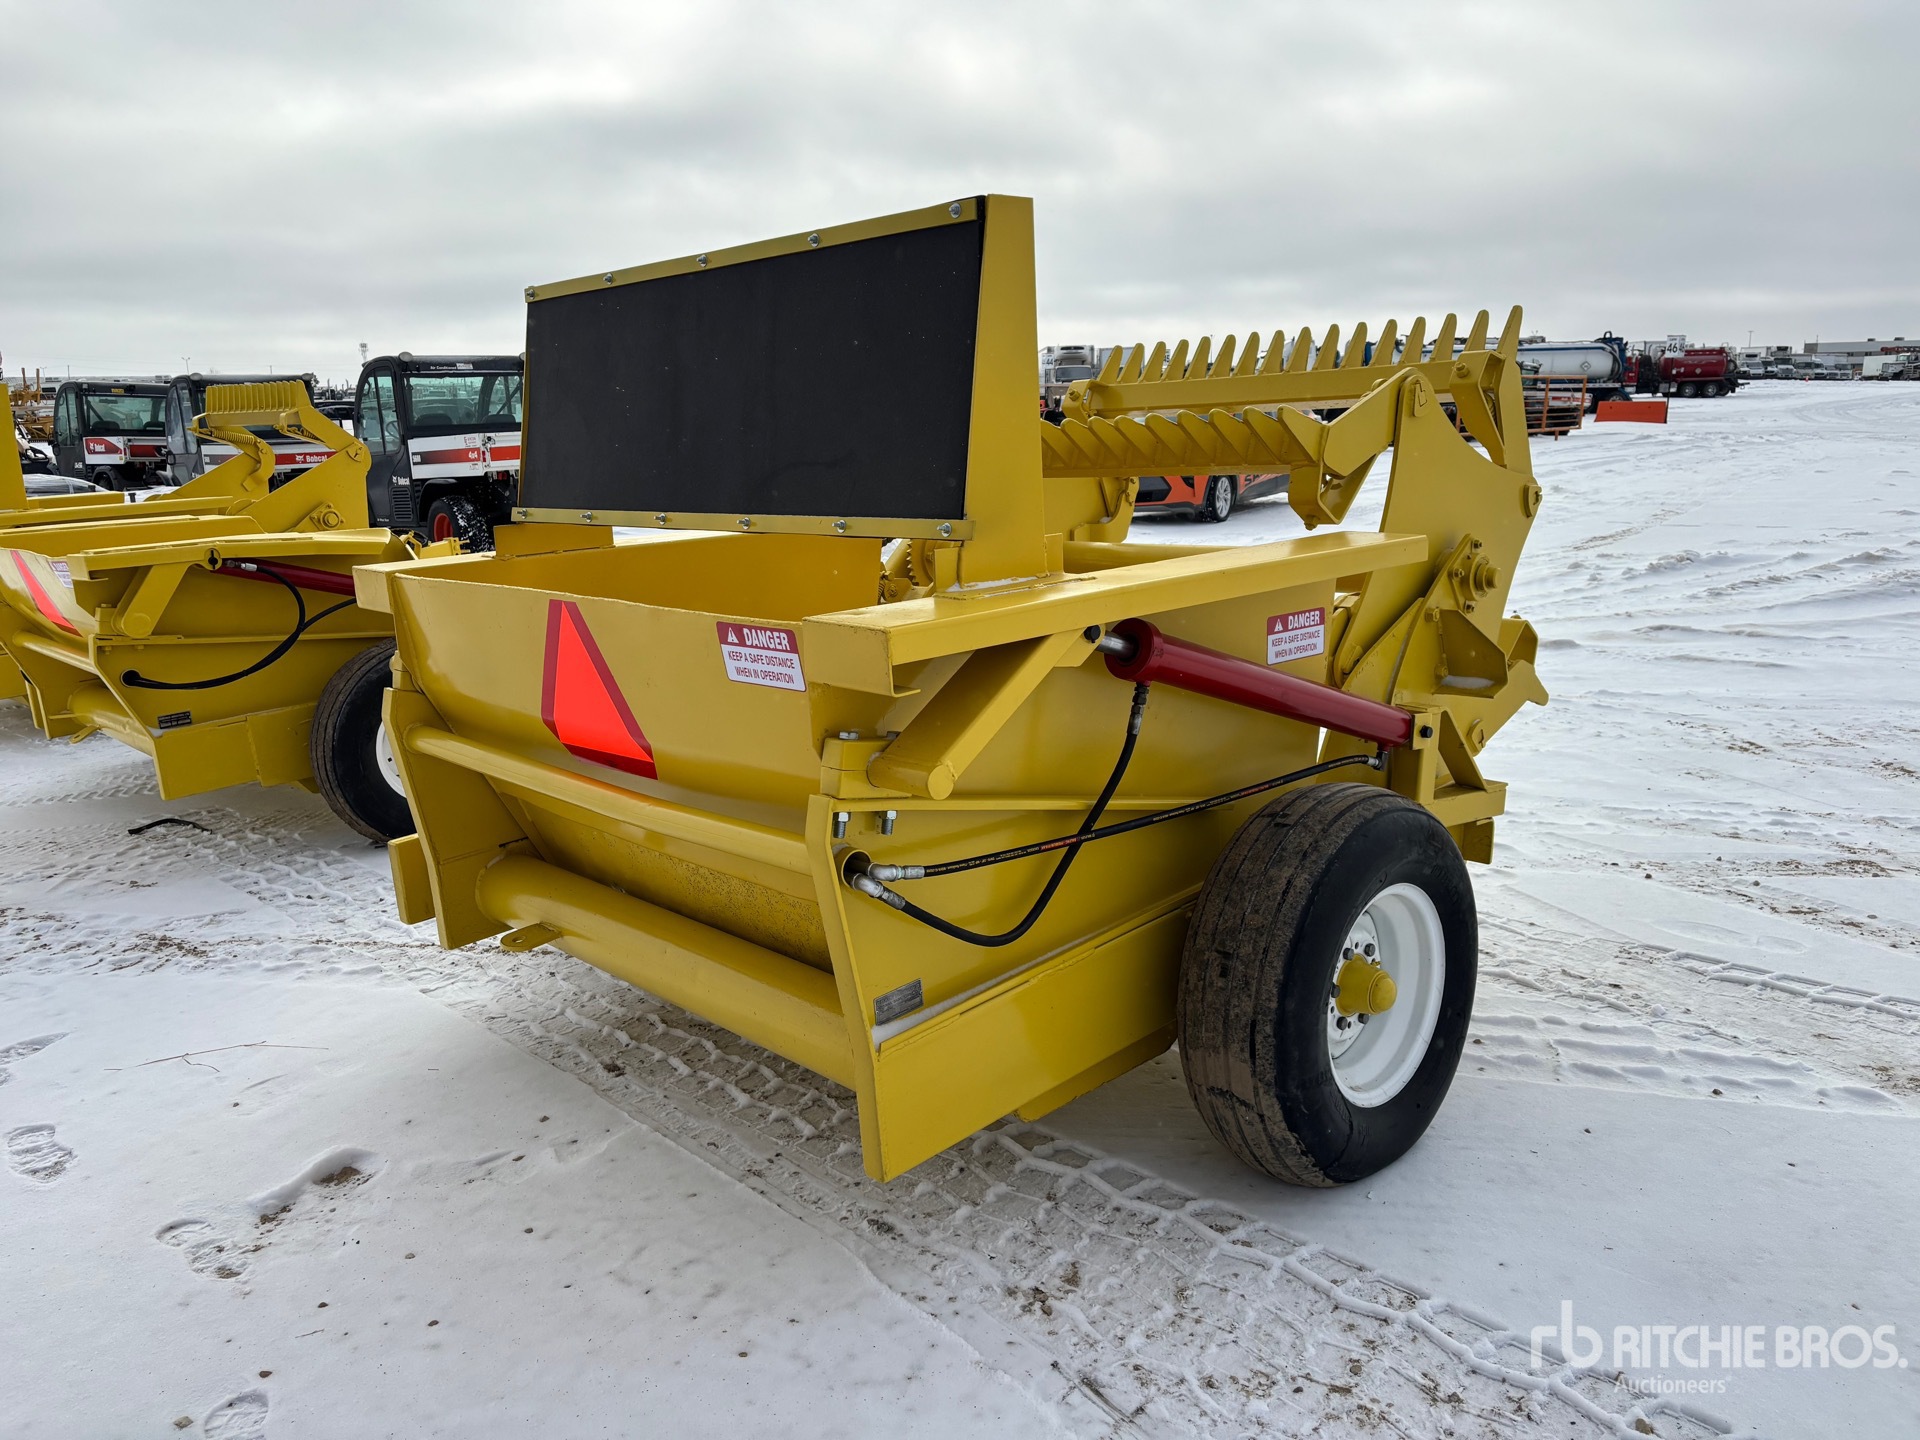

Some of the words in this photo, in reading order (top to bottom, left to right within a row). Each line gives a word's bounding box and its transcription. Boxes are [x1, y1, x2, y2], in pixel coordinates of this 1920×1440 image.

[1667, 342, 1678, 353] 46
[306, 454, 328, 463] Bobcat
[397, 476, 410, 486] Bobcat
[1288, 610, 1320, 630] DANGER
[743, 627, 791, 651] DANGER
[1272, 636, 1283, 648] KEEP
[1288, 634, 1299, 644] SAFE
[1299, 630, 1321, 641] DISTANCE
[728, 650, 743, 662] KEEP
[743, 652, 749, 662] A
[749, 653, 765, 665] SAFE
[765, 655, 795, 669] DISTANCE
[1274, 648, 1287, 659] WHEN
[1293, 642, 1318, 655] OPERATION
[735, 666, 753, 678] WHEN
[753, 669, 760, 679] IN
[760, 670, 795, 684] OPERATION
